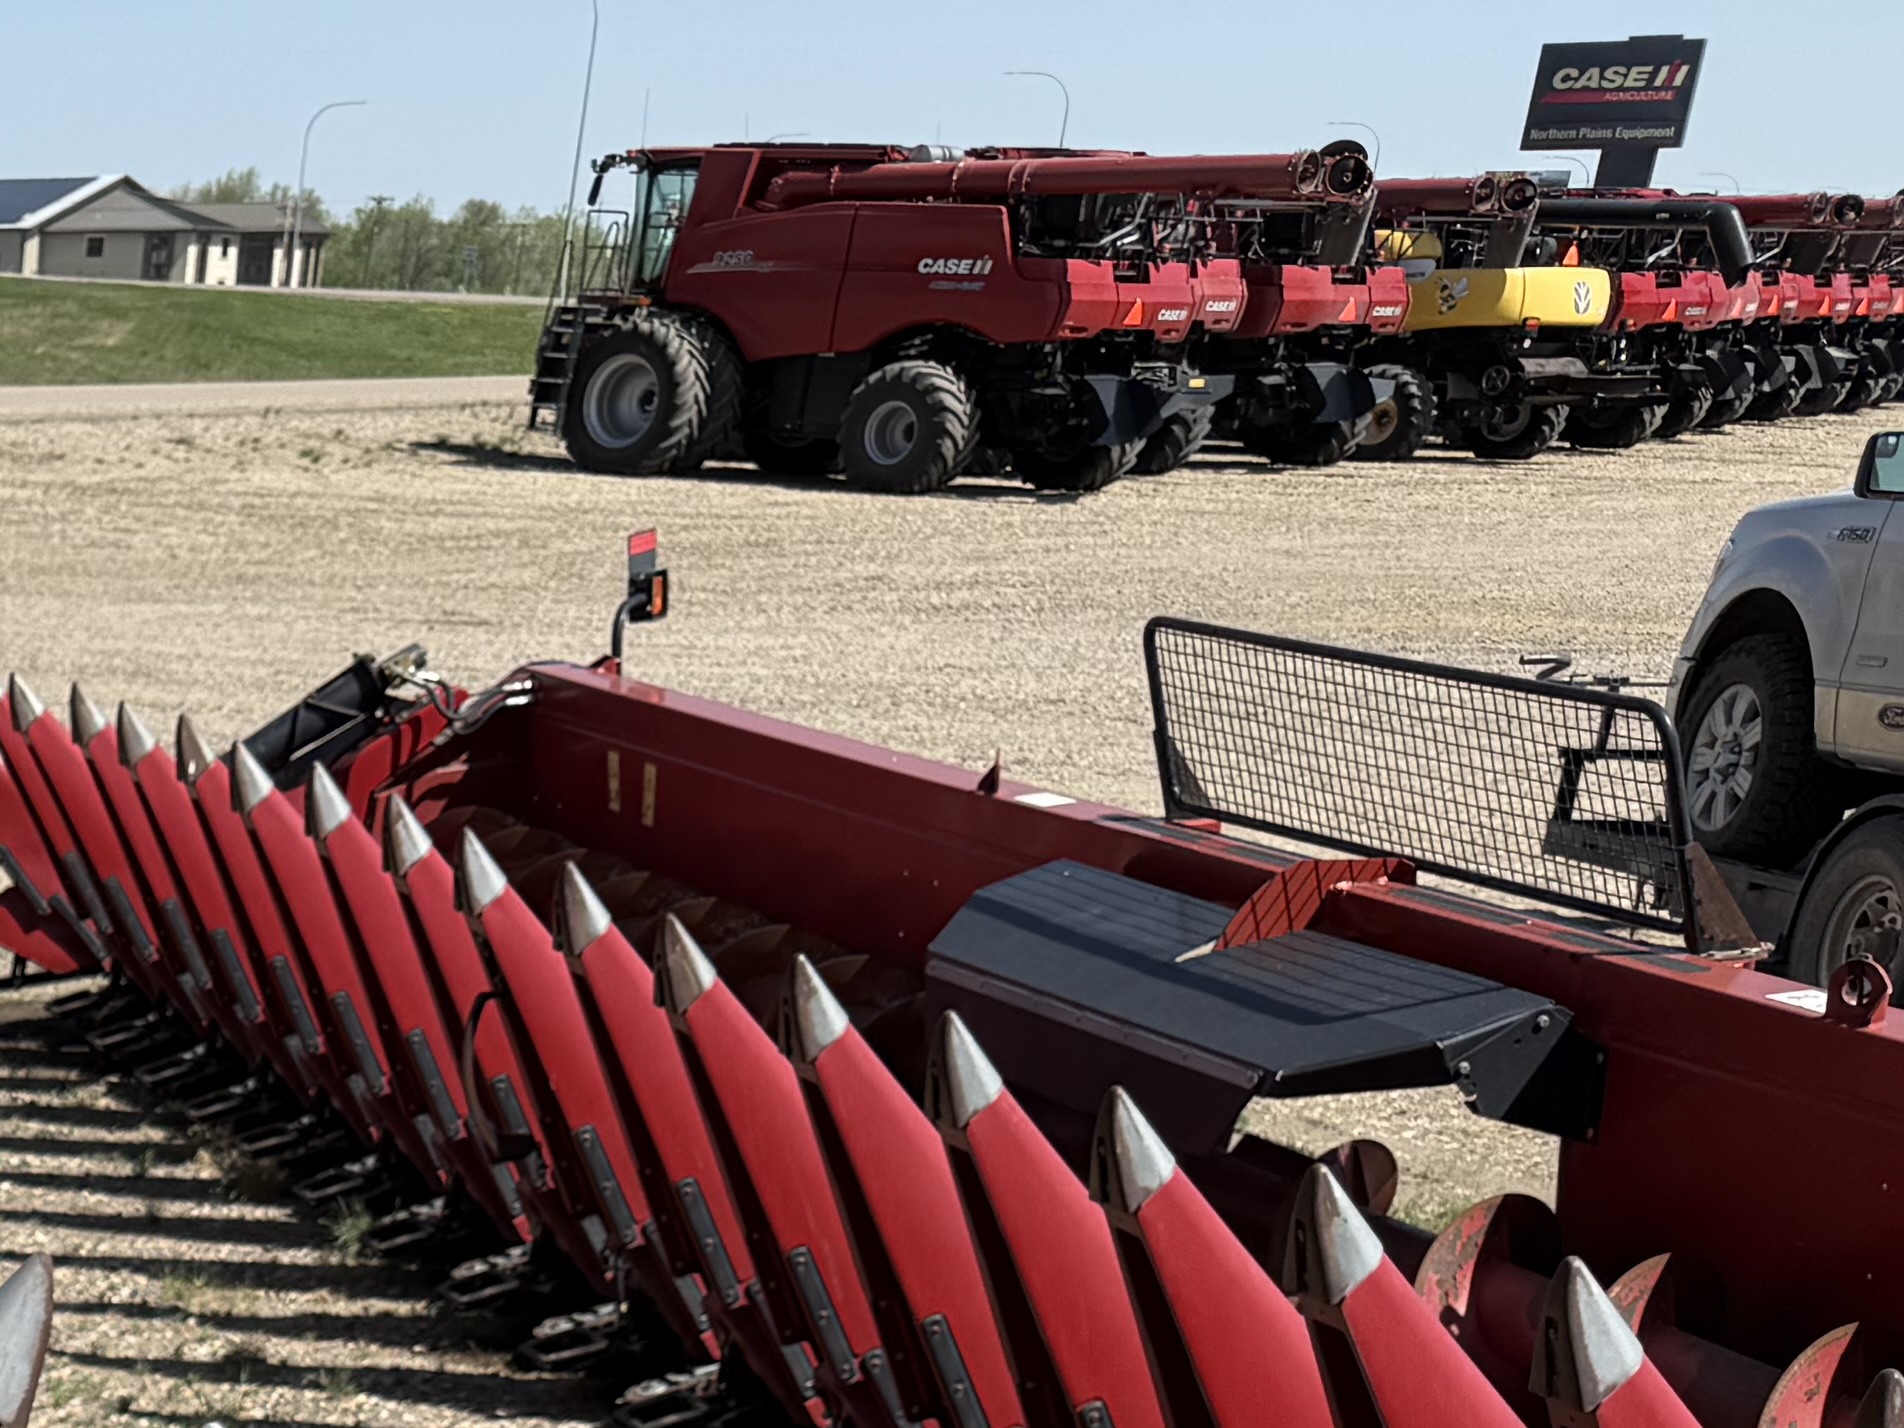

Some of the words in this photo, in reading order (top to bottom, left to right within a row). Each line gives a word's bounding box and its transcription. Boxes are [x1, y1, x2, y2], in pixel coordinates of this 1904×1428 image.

[1552, 65, 1653, 90] CASE
[1530, 128, 1576, 140] Northern
[1579, 127, 1613, 138] Plains
[1615, 126, 1675, 140] Equipment
[918, 258, 974, 274] CASE
